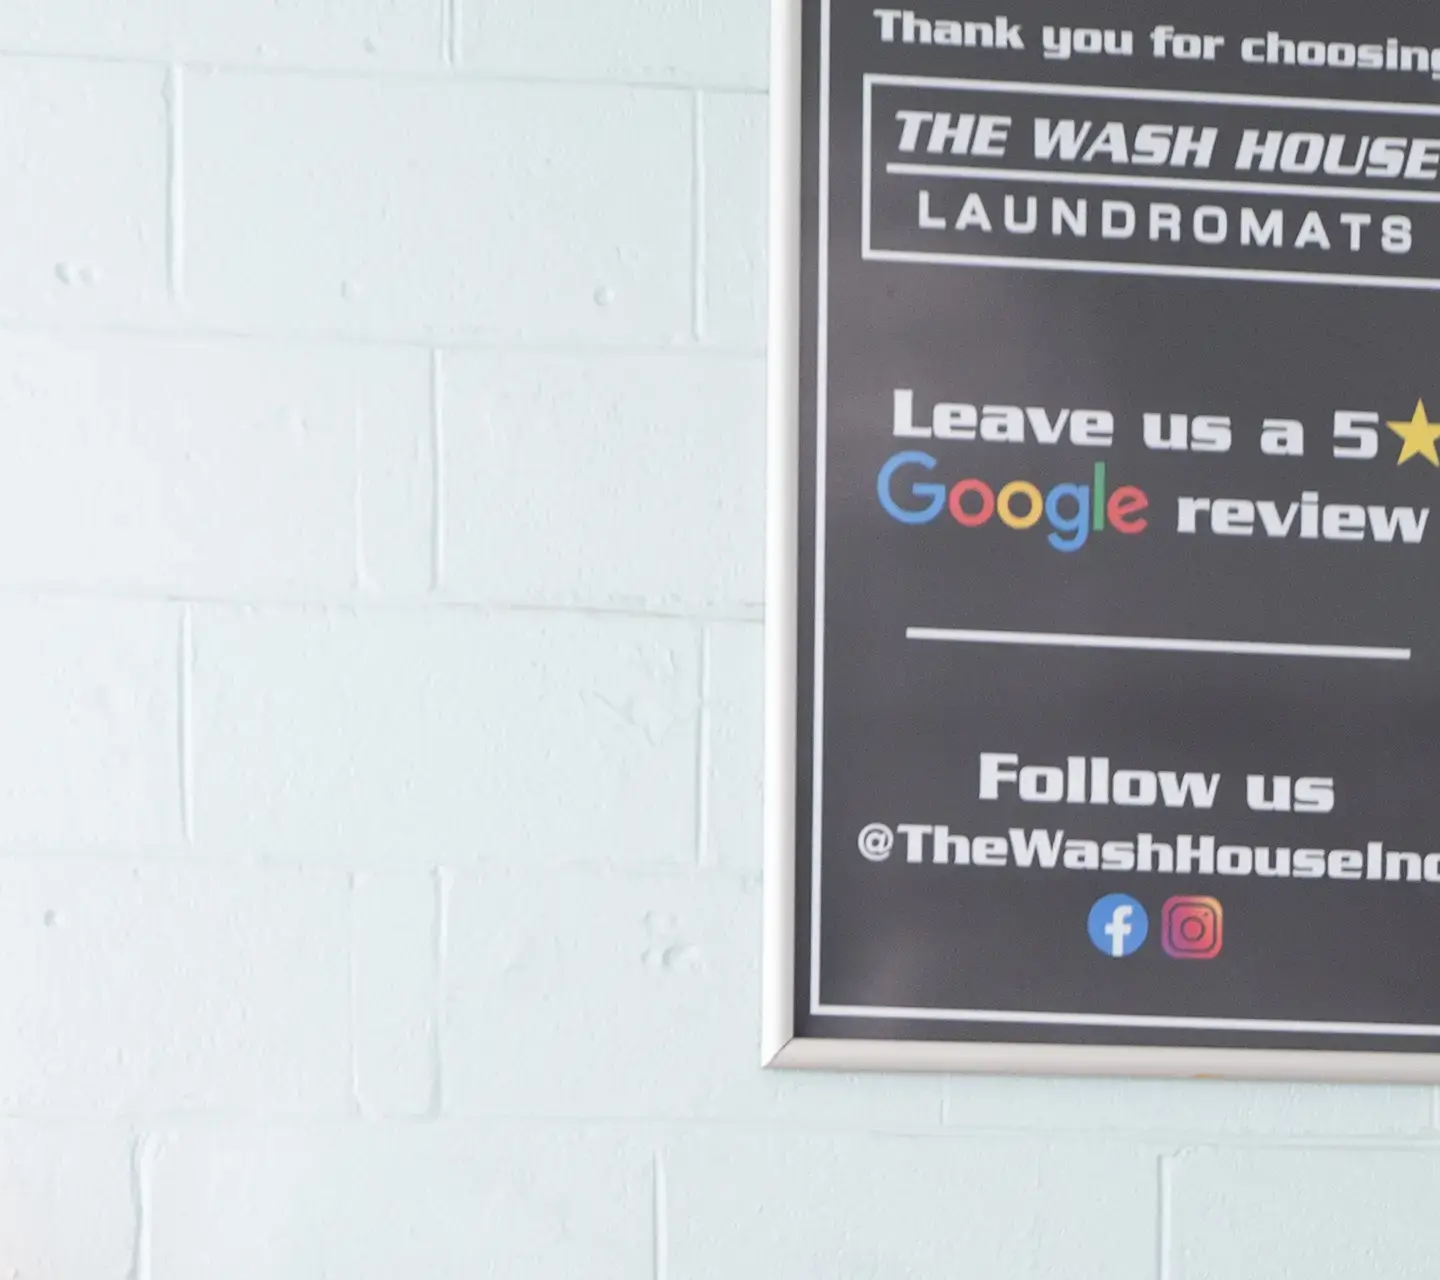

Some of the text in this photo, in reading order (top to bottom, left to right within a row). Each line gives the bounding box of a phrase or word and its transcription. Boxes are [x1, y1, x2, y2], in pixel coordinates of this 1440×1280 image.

[872, 8, 1025, 49] Thank
[1042, 26, 1133, 60] you
[1150, 25, 1225, 60] for
[895, 110, 1012, 157] THE
[1034, 117, 1218, 168] WASH
[918, 190, 1413, 254] LAUNDROMATS
[892, 388, 1379, 459] Leave us a 5
[876, 450, 1430, 552] Google review
[978, 752, 1335, 813] Follow us
